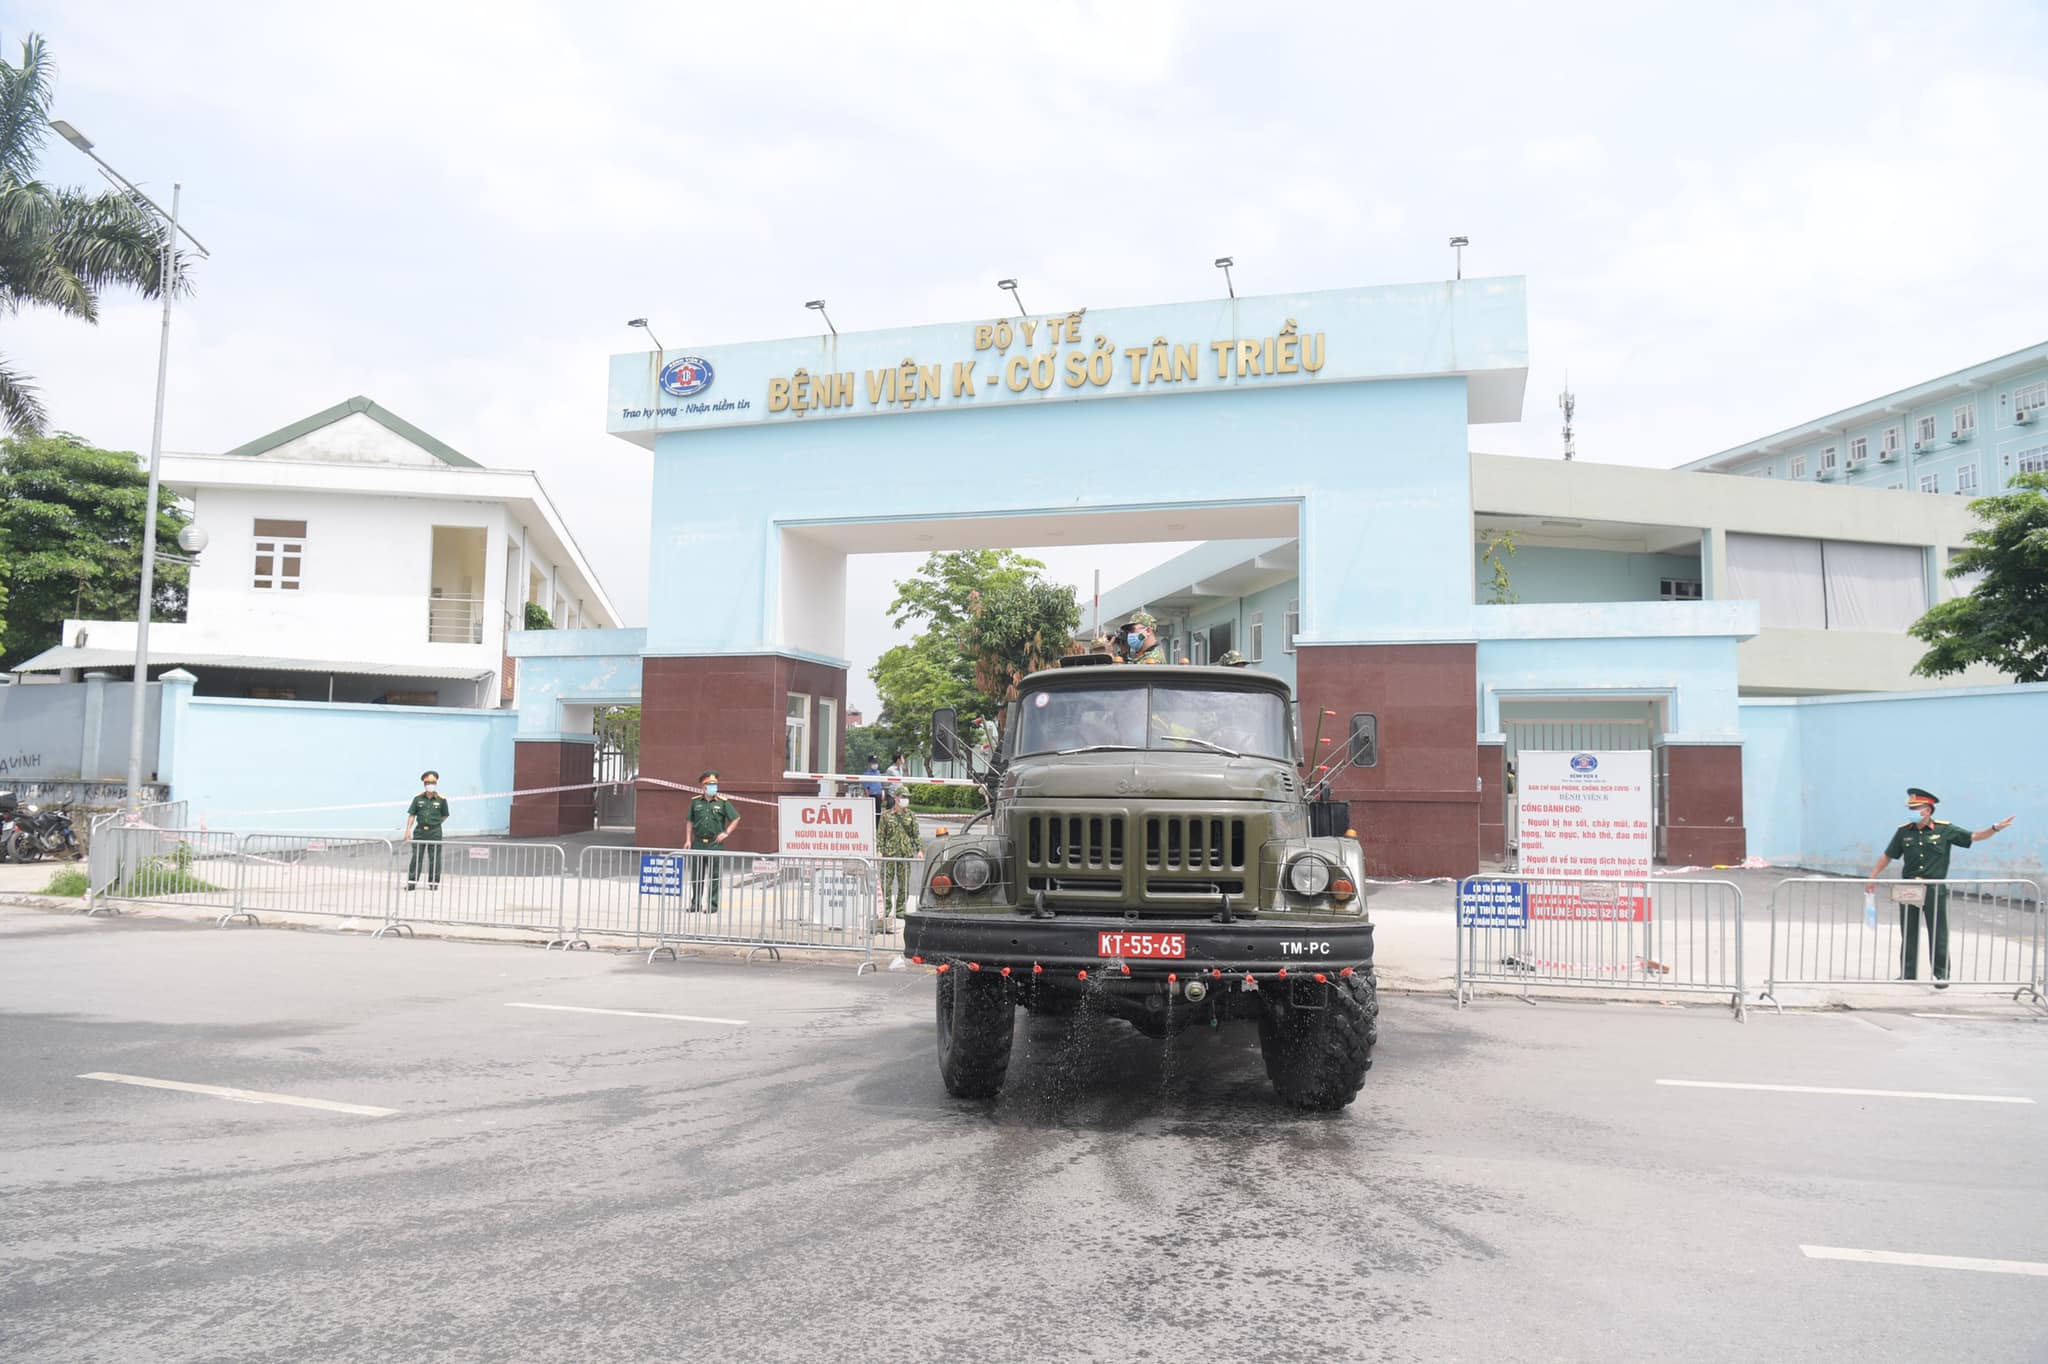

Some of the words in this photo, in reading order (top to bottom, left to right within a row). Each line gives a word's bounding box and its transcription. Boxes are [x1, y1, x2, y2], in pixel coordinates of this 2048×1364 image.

[974, 319, 1015, 355] BỘ
[1019, 320, 1036, 346] Y
[1048, 307, 1088, 344] TẾ
[768, 366, 855, 416] BỆNH
[864, 357, 942, 408] VIỆN
[953, 361, 978, 398] K
[1007, 350, 1060, 392] CƠ
[1064, 336, 1116, 388] SỞ
[1124, 336, 1199, 384] TÂN
[1211, 319, 1326, 379] TRIỀU
[622, 409, 641, 419] Trao
[656, 407, 678, 417] vọng
[685, 403, 710, 414] Nhận
[712, 399, 735, 411] niềm
[737, 399, 751, 409] tin
[801, 802, 853, 825] CẤM
[845, 831, 859, 839] QUA
[786, 842, 811, 851] KHUÔN
[812, 842, 829, 851] VIÊN
[830, 843, 850, 853] BỆNH
[852, 843, 869, 853] VIỆN
[1100, 935, 1184, 957] KT-55-65
[1280, 941, 1330, 956] TM-PC
